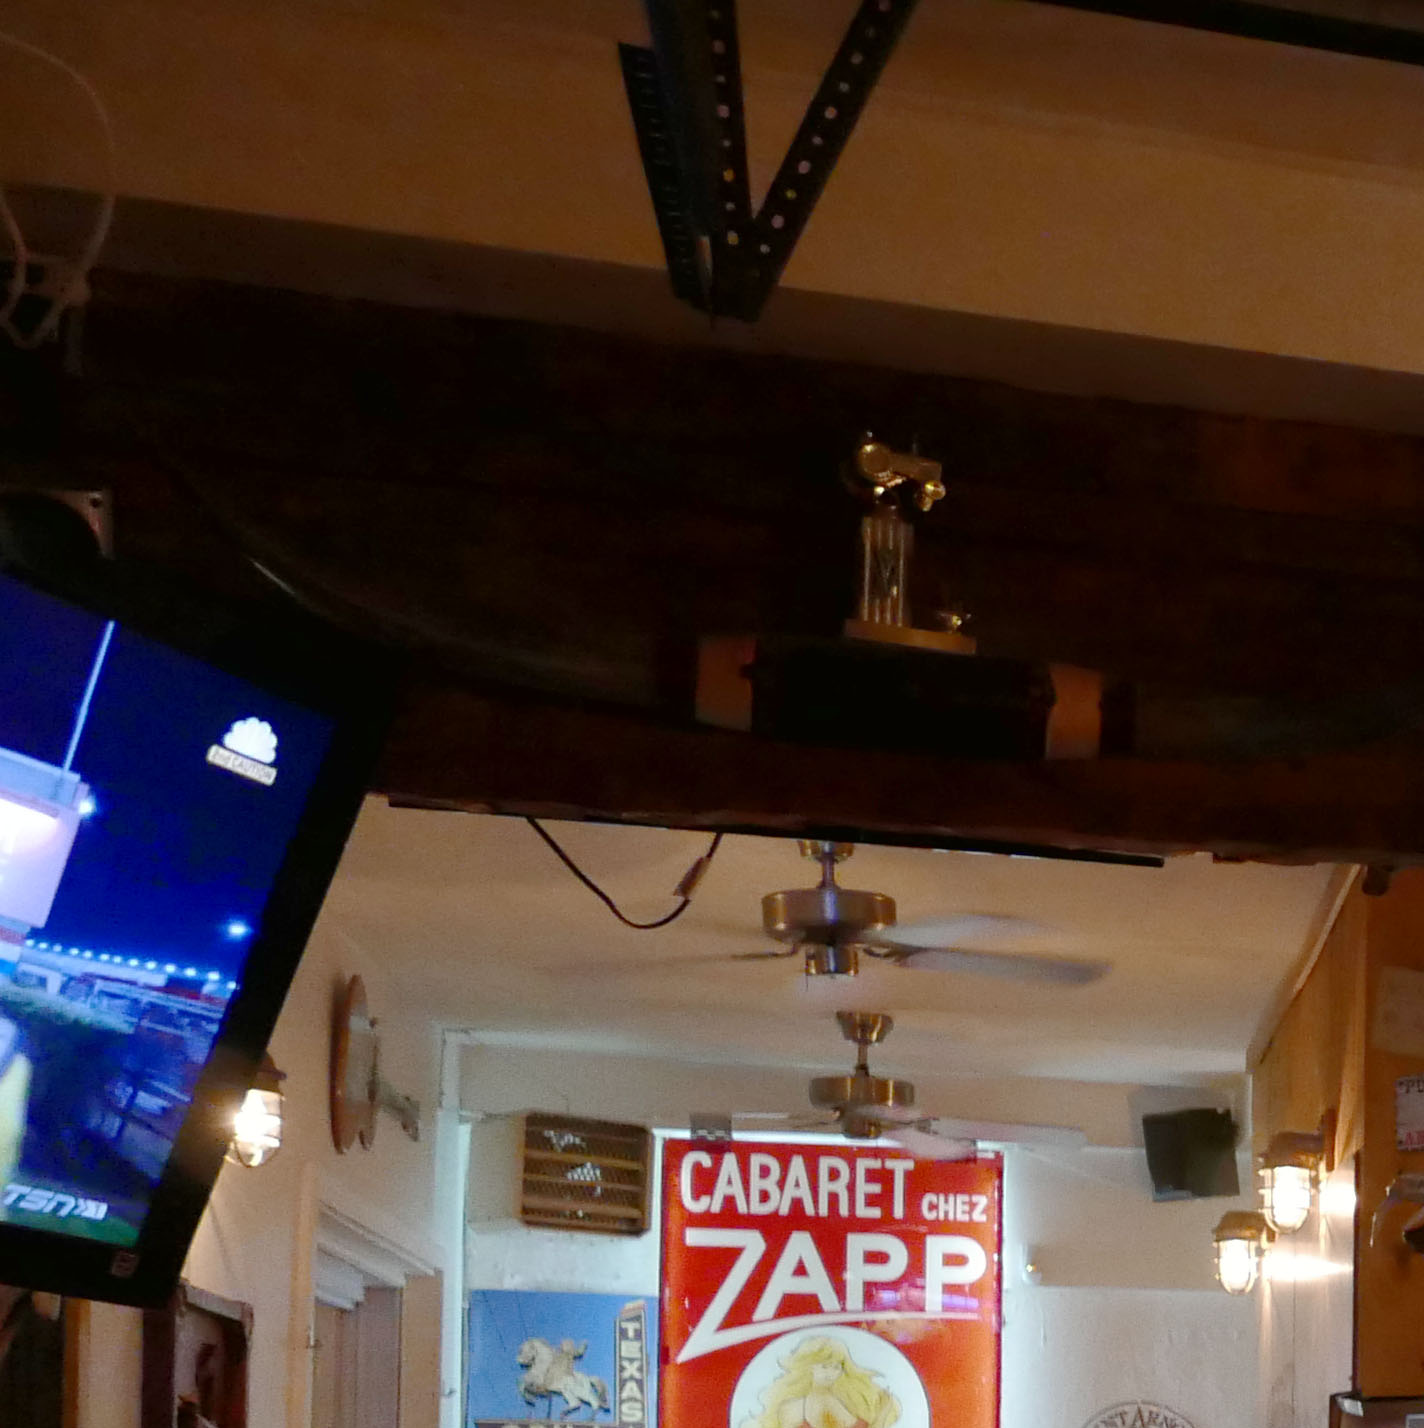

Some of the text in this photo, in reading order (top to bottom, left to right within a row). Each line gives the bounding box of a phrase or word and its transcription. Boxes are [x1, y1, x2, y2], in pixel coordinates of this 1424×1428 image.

[680, 1148, 988, 1223] CABARET CHEZ
[675, 1226, 988, 1365] ZAPP
[619, 1319, 644, 1424] TEXAS
